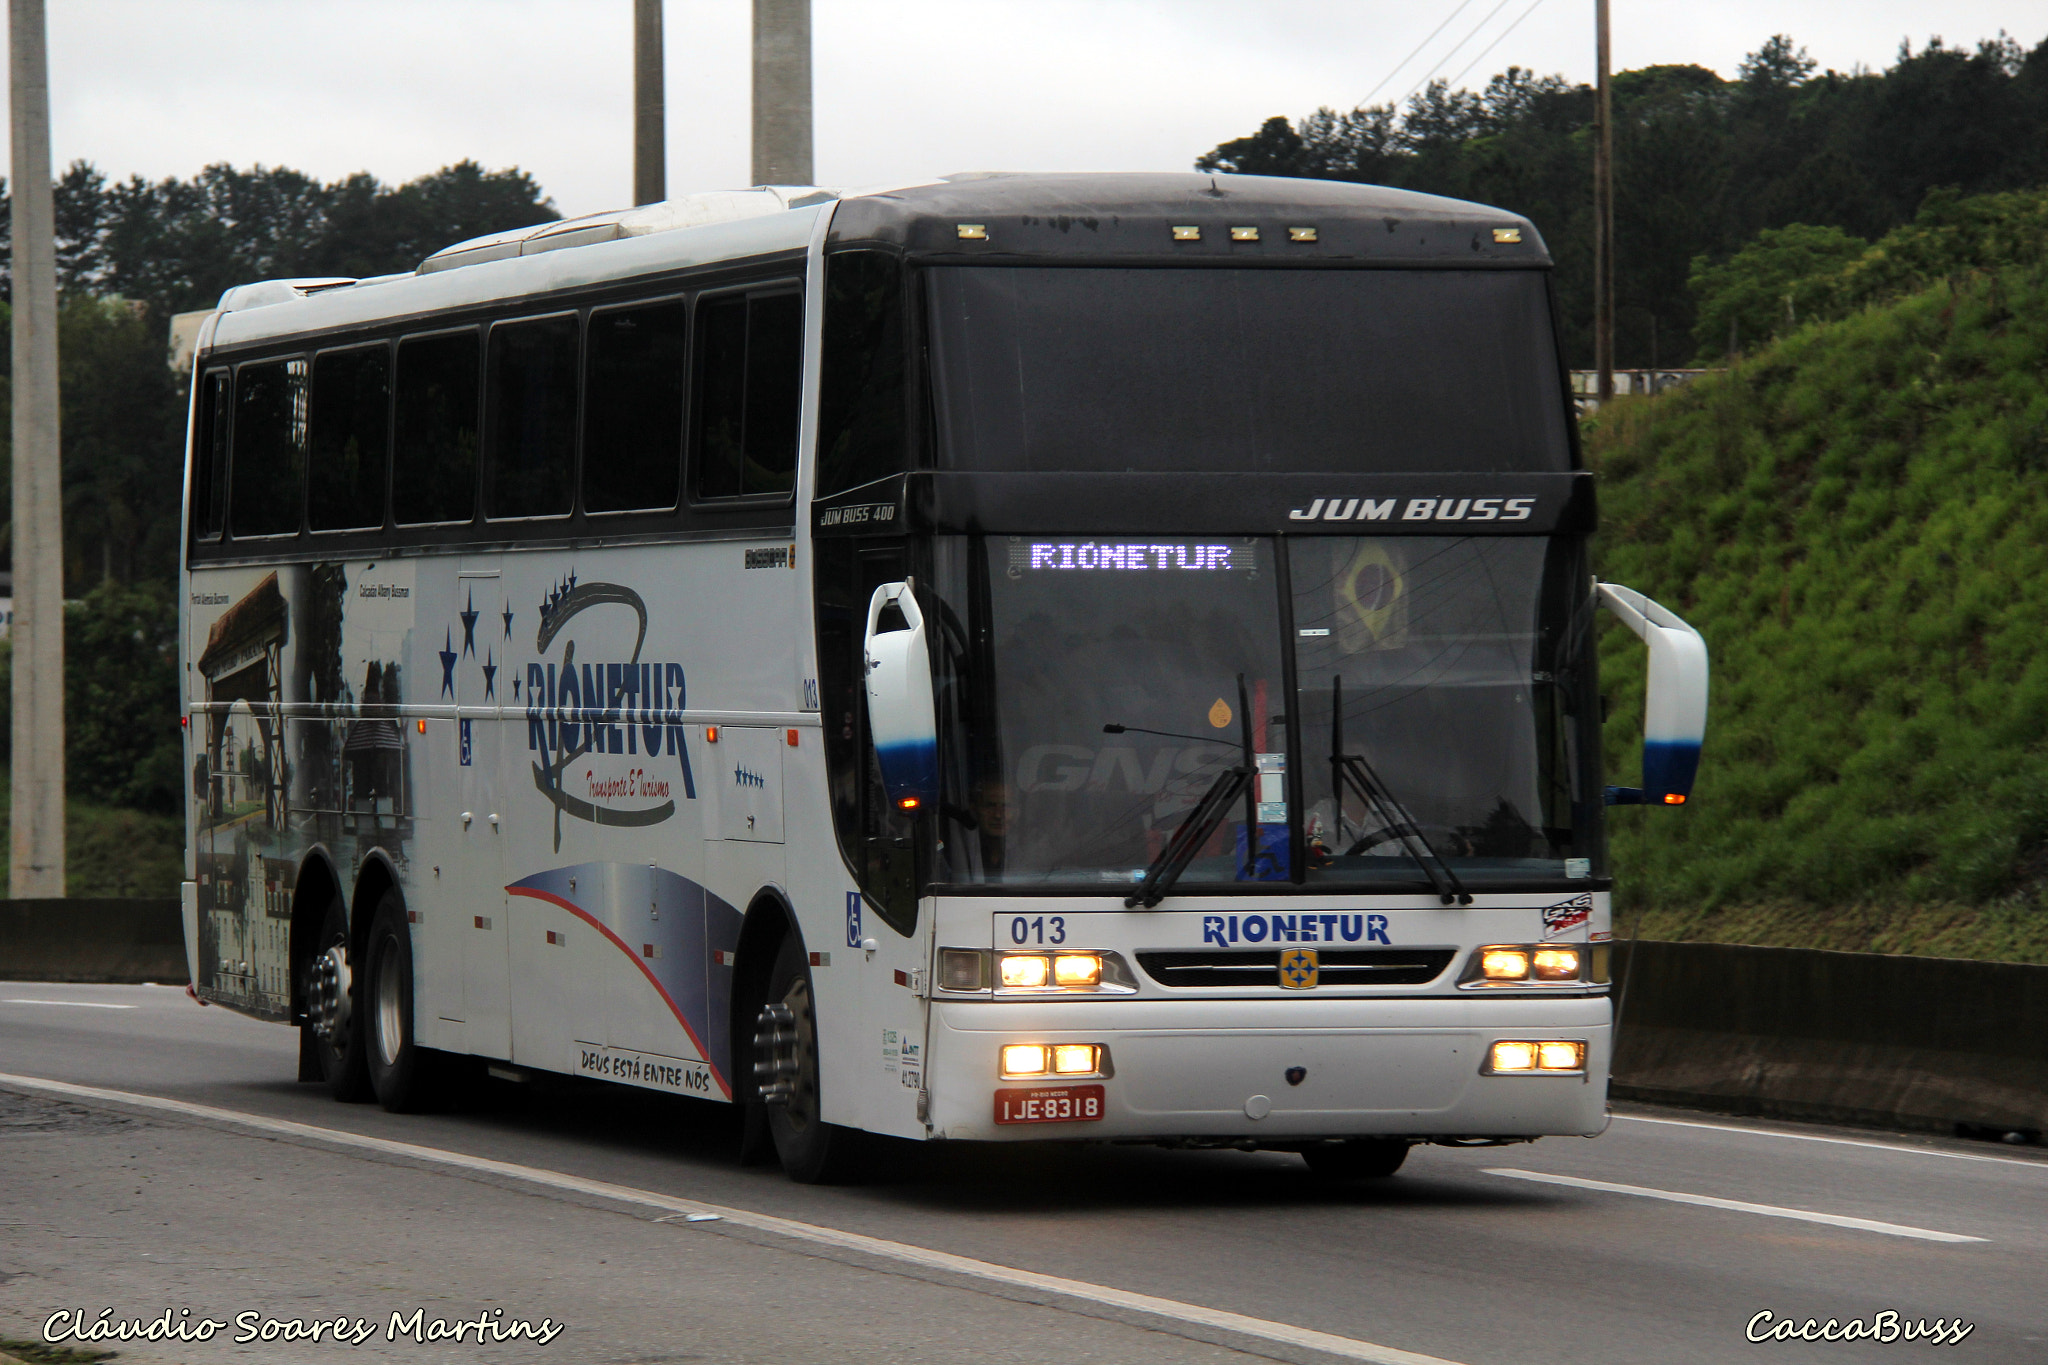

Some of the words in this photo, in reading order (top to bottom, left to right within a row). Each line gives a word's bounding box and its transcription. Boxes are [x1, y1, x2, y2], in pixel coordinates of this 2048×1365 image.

[820, 509, 842, 526] JUM
[842, 506, 870, 524] BUSS
[873, 505, 895, 521] 400
[1289, 498, 1398, 521] JUM
[1401, 498, 1537, 521] BUSS
[803, 678, 818, 709] 013
[586, 769, 628, 804] Transporte
[629, 768, 636, 797] E
[637, 768, 670, 798] Turismo
[1011, 916, 1066, 945] 013
[1203, 914, 1392, 948] RIONETUR
[581, 1050, 610, 1074] DEUS
[613, 1055, 641, 1080] ESTÁ
[643, 1063, 682, 1087] ENTRE
[685, 1065, 710, 1092] NÓS
